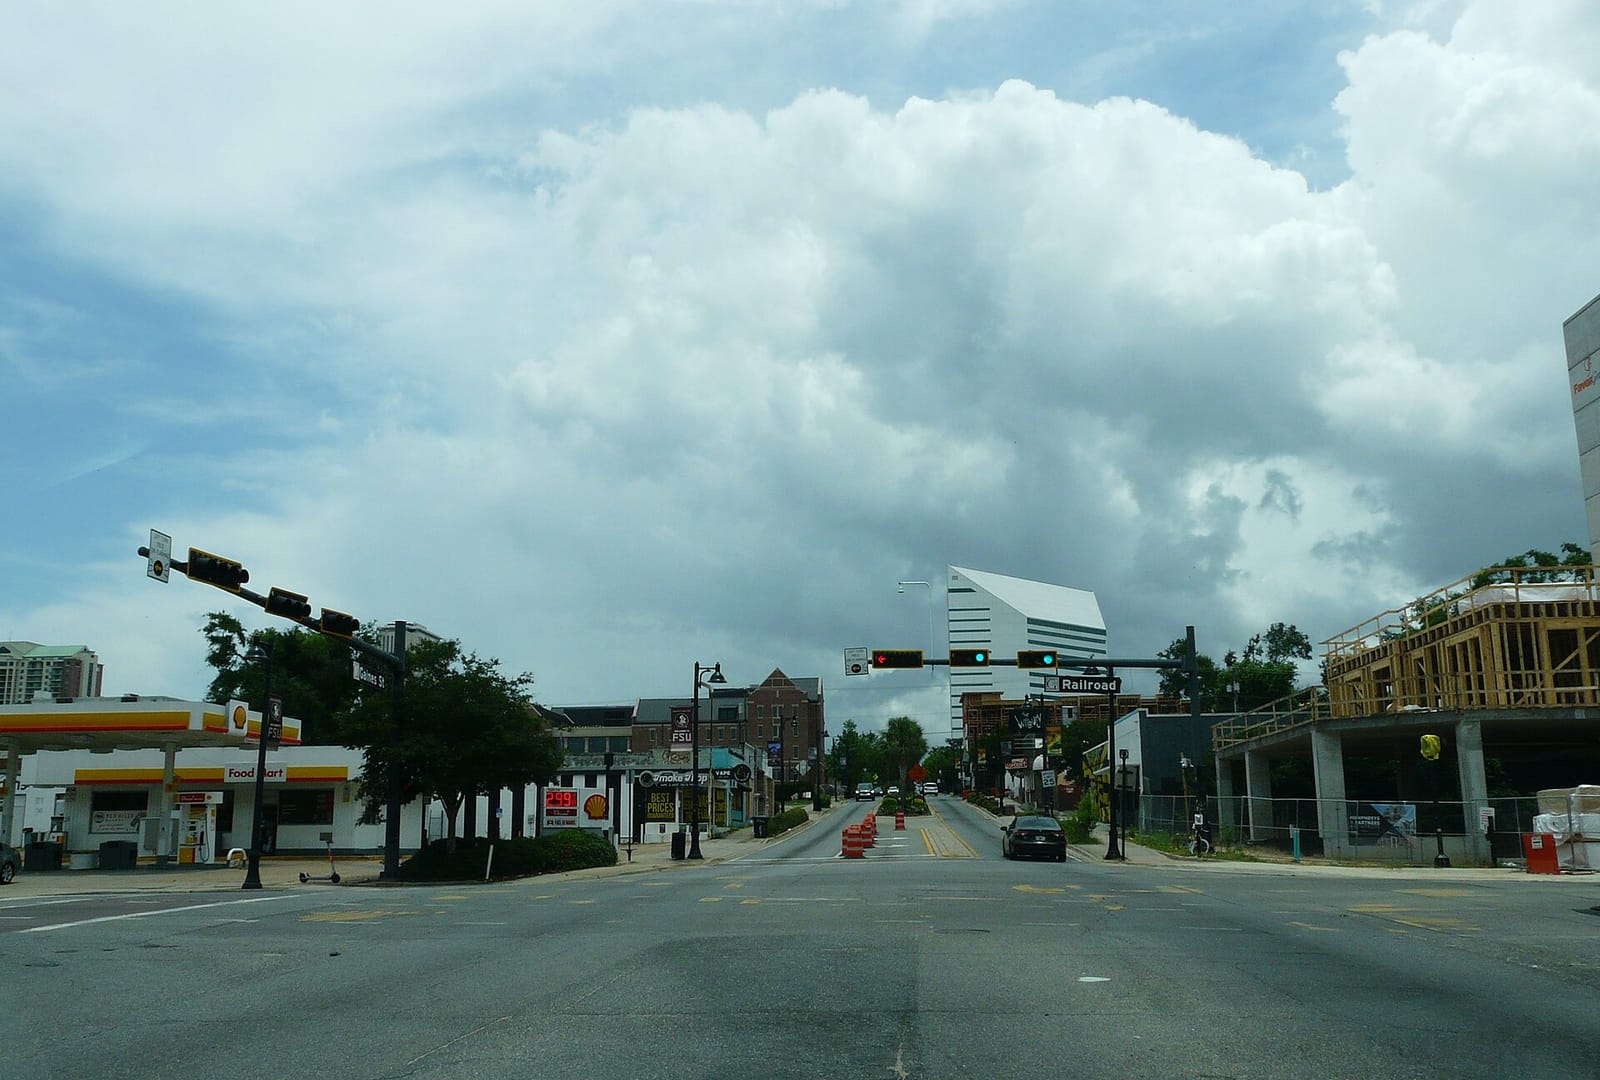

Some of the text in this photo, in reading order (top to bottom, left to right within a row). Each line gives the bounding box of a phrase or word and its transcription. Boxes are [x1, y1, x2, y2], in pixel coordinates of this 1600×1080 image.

[1062, 679, 1117, 691] Railroad
[672, 733, 692, 742] FSU
[228, 768, 284, 778] Food art
[1043, 778, 1055, 786] 25
[651, 792, 670, 803] BEST
[647, 802, 675, 813] PRICES
